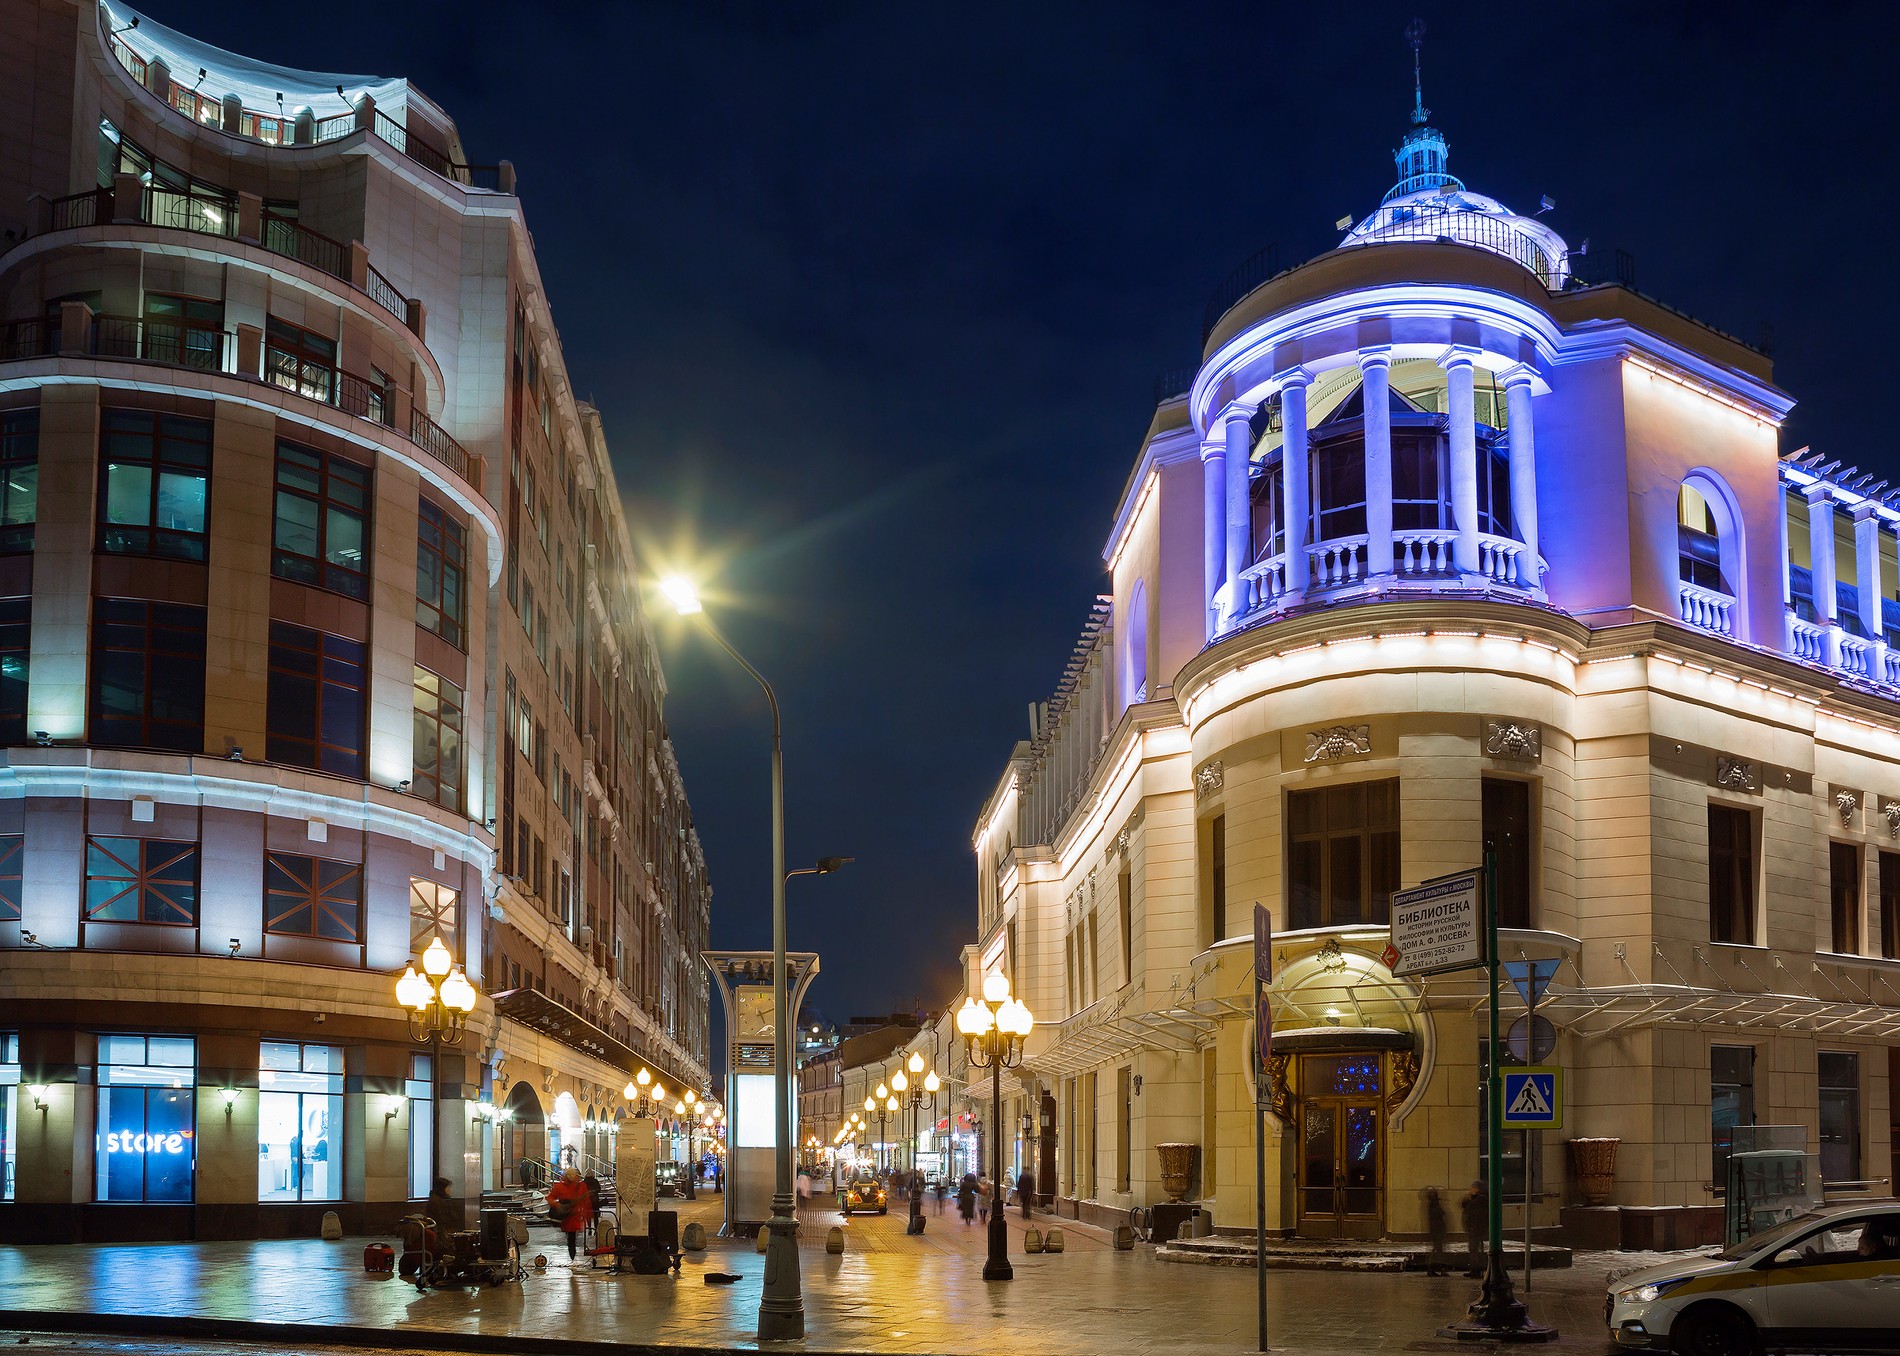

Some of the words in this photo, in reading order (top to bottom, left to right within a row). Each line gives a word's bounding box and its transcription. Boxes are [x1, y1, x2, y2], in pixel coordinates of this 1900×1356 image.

[1398, 900, 1470, 925] БИБЛИОТЕКА
[1398, 929, 1434, 941] ФИЛОСОФИИ
[1440, 921, 1471, 933] КУЛЬТУРЫ
[1407, 921, 1433, 931] ИСТОРИИ
[1434, 914, 1460, 926] РУССКОЙ
[1419, 939, 1426, 947] А.
[1427, 937, 1436, 945] Ф.
[1417, 950, 1433, 961] (499)
[1434, 944, 1465, 956] 252-82-72
[1406, 960, 1425, 970] АРБАТ
[106, 1128, 184, 1154] store
